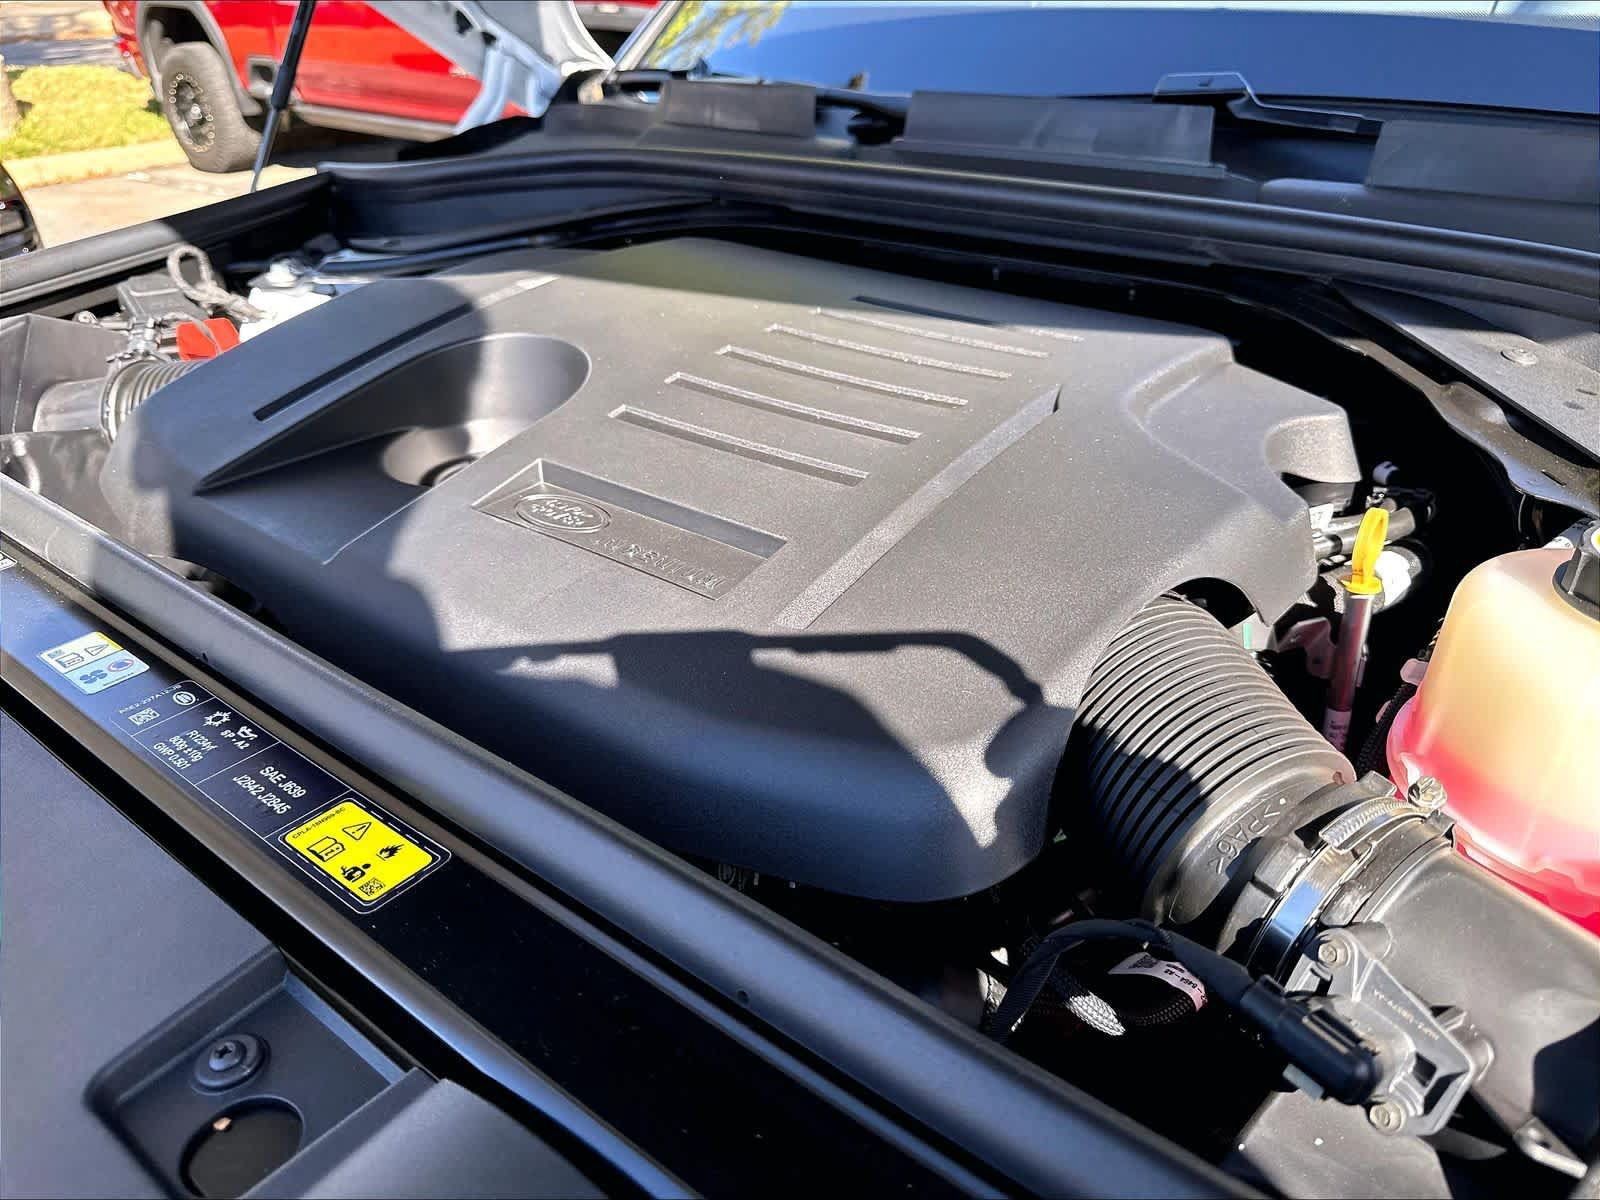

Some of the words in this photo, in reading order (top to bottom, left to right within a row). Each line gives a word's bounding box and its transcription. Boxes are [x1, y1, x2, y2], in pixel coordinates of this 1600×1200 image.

[153, 742, 175, 755] GWP
[168, 754, 192, 770] 0.501
[185, 730, 218, 752] R1234yf
[232, 774, 265, 796] J2842
[257, 792, 292, 814] J2845
[259, 766, 286, 784] SAE
[278, 780, 306, 798] J639
